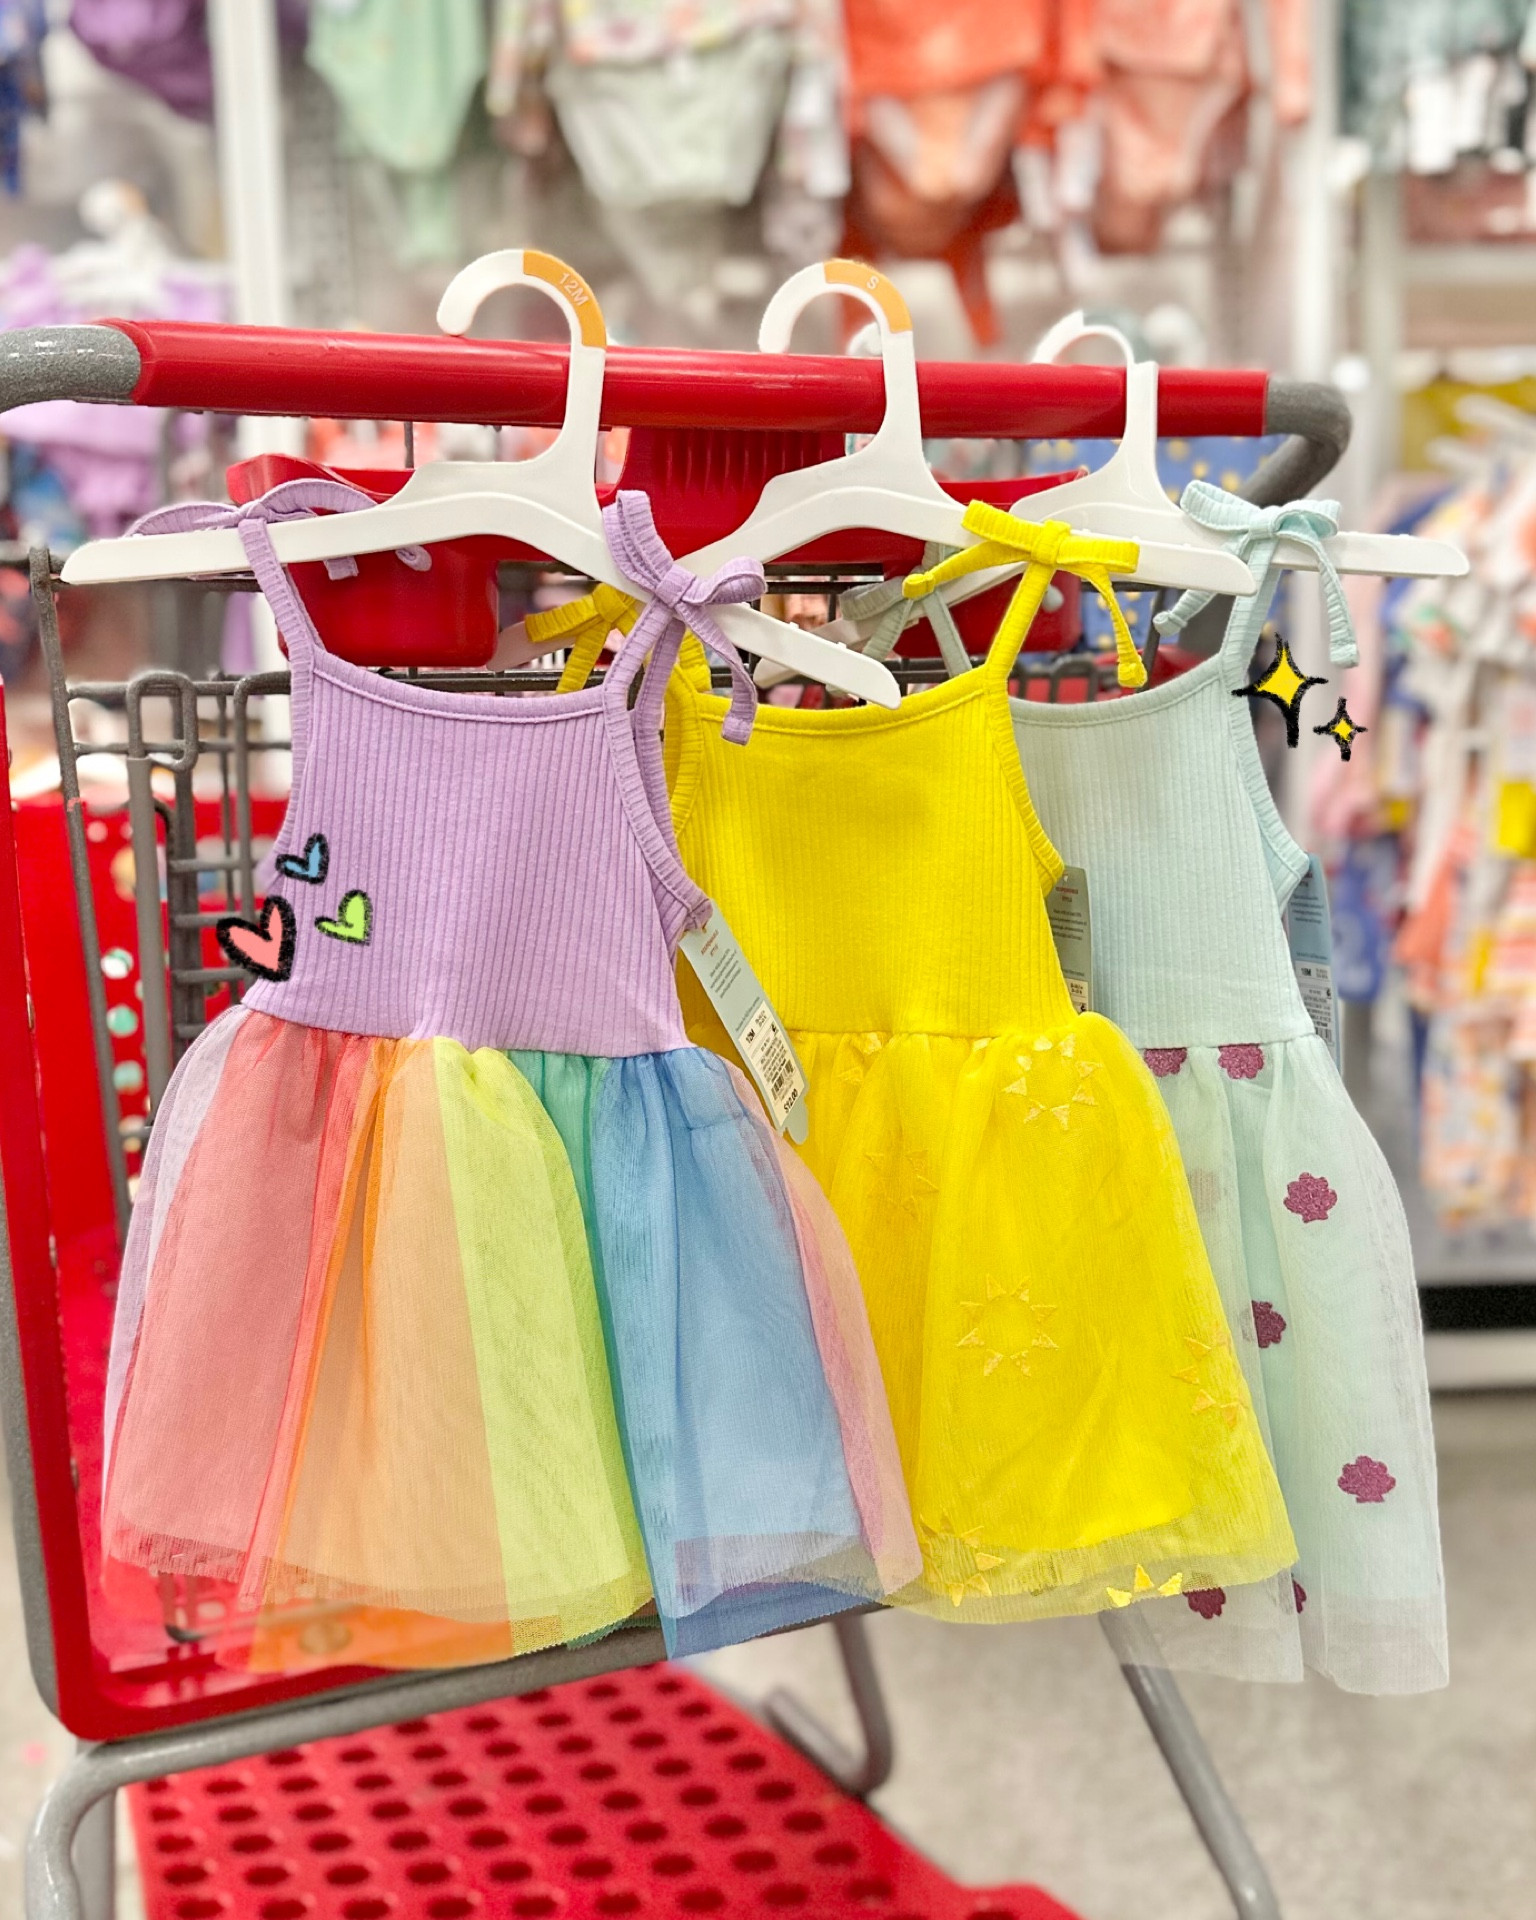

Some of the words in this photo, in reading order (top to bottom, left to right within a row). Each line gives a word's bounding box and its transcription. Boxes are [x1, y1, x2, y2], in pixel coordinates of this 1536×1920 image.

[559, 273, 589, 306] 12M
[867, 276, 880, 289] S
[784, 1089, 798, 1113] $12.00
